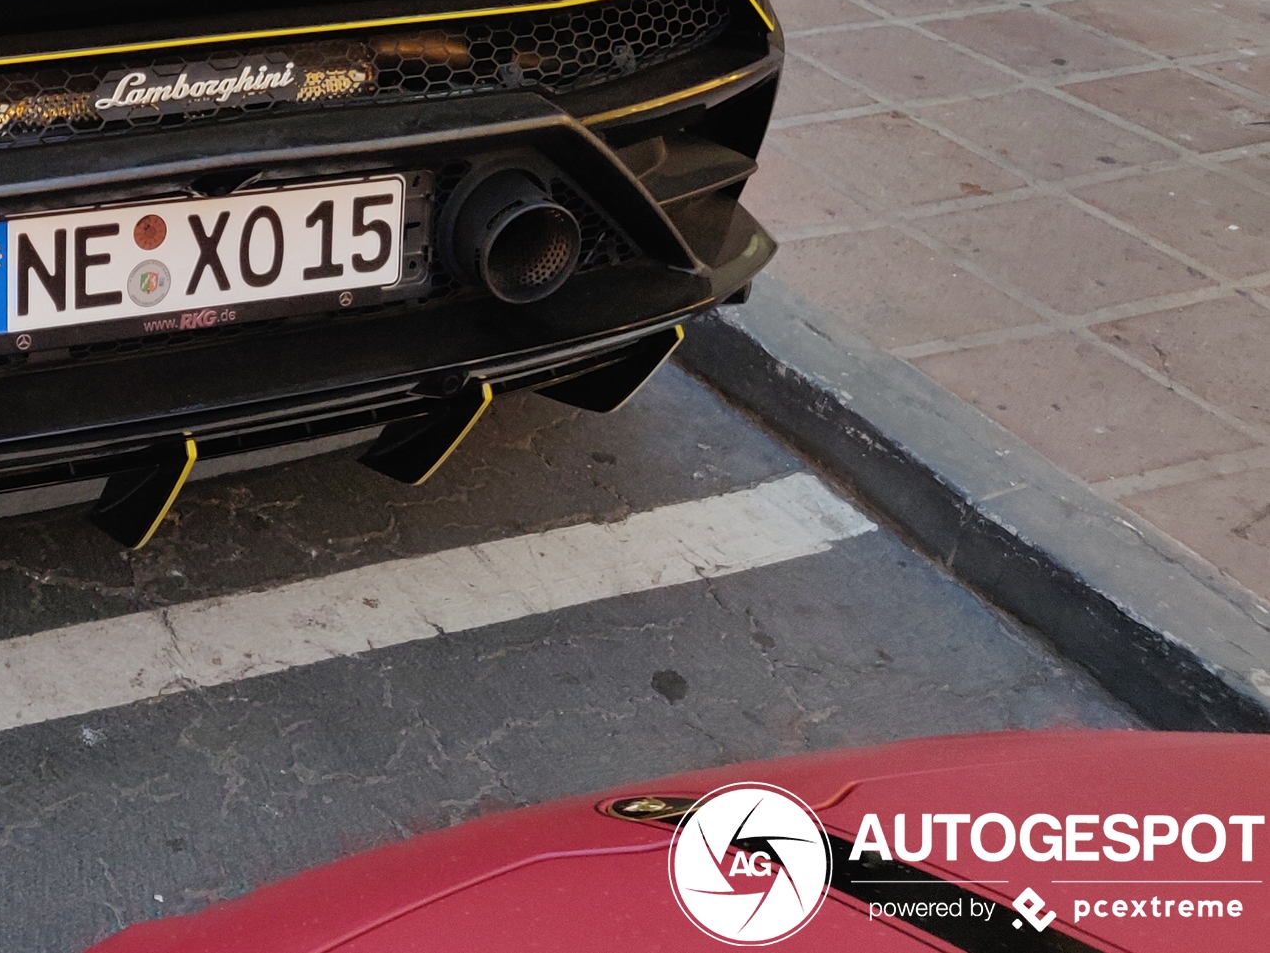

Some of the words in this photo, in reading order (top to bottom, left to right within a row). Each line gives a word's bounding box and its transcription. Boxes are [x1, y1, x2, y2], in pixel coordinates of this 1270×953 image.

[94, 61, 296, 110] Lamborghini
[17, 222, 123, 317] NE
[185, 205, 285, 296] XO
[302, 193, 394, 281] 15
[143, 308, 237, 332] www.RKG.de
